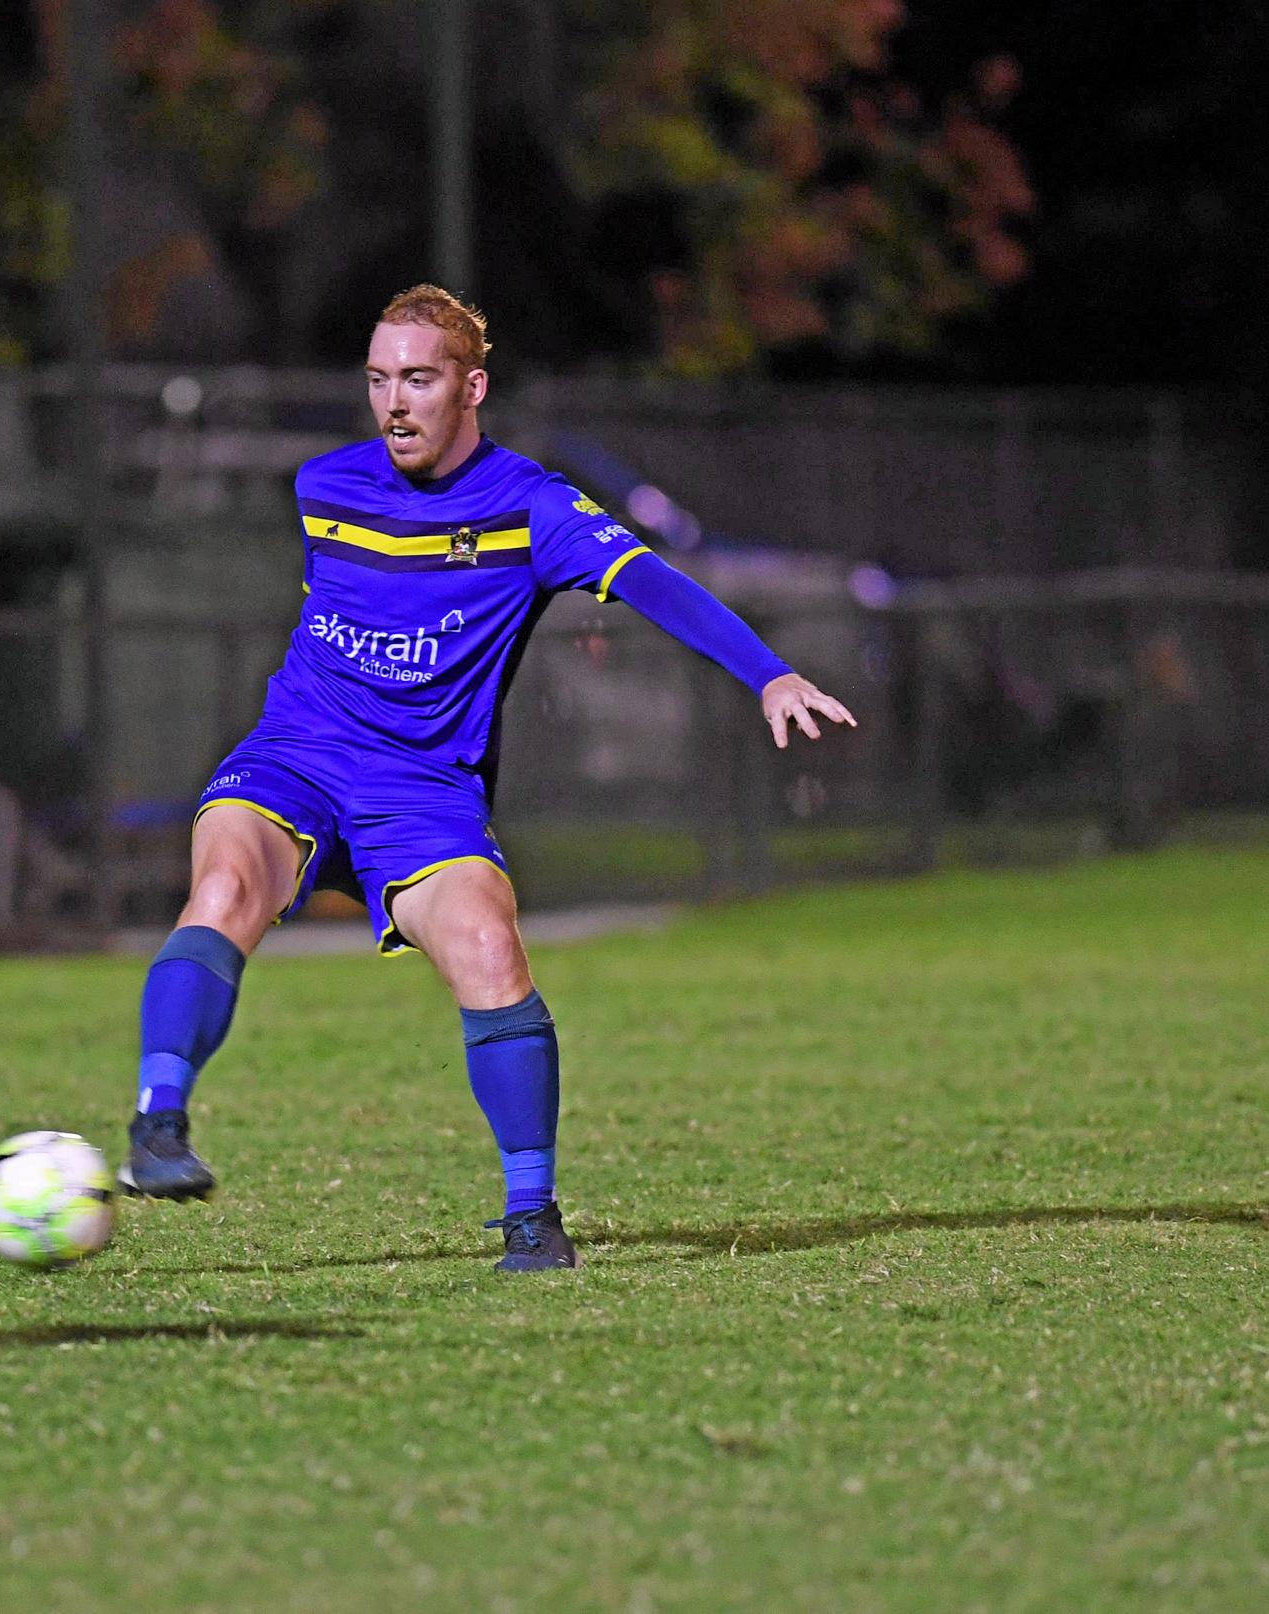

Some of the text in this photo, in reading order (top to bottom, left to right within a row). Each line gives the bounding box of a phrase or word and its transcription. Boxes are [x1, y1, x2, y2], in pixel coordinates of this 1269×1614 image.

[308, 613, 439, 666] akyrah
[359, 656, 434, 684] kitchens
[201, 773, 241, 800] yrah
